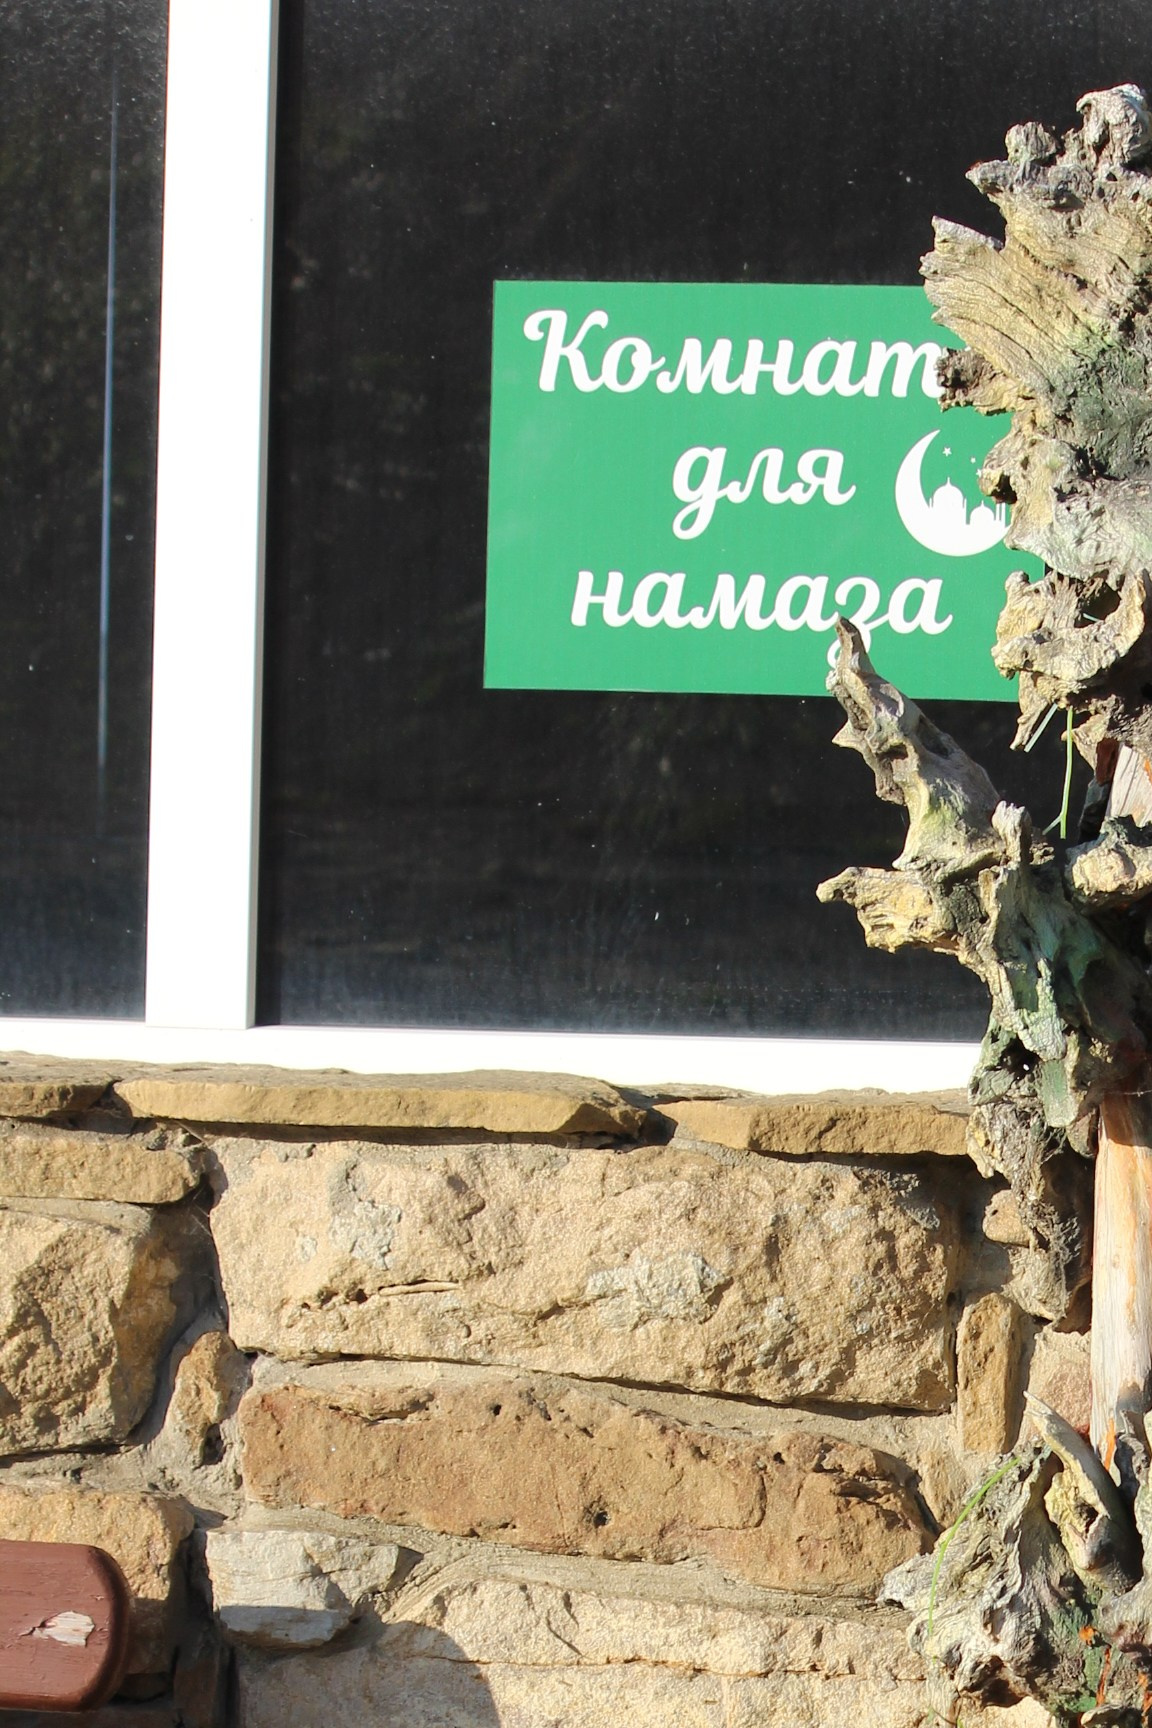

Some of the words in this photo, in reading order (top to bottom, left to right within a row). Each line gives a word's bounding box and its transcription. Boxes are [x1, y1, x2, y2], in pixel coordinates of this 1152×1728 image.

[523, 309, 972, 399] Комнат
[672, 446, 856, 540] для
[571, 570, 953, 667] намаза
